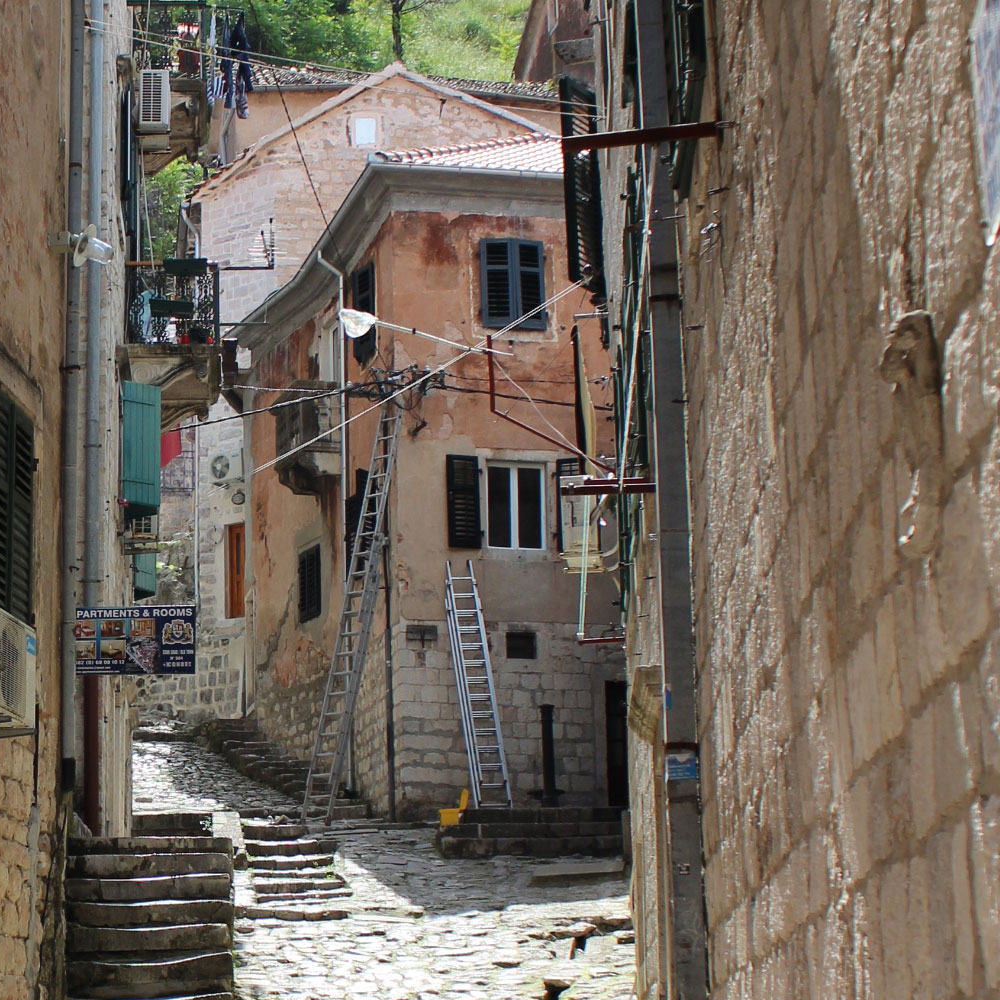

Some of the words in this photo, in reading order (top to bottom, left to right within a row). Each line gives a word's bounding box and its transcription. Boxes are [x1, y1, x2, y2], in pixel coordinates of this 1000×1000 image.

[76, 609, 140, 618] PARTMENTS
[142, 609, 150, 617] &
[153, 608, 193, 617] ROOMS
